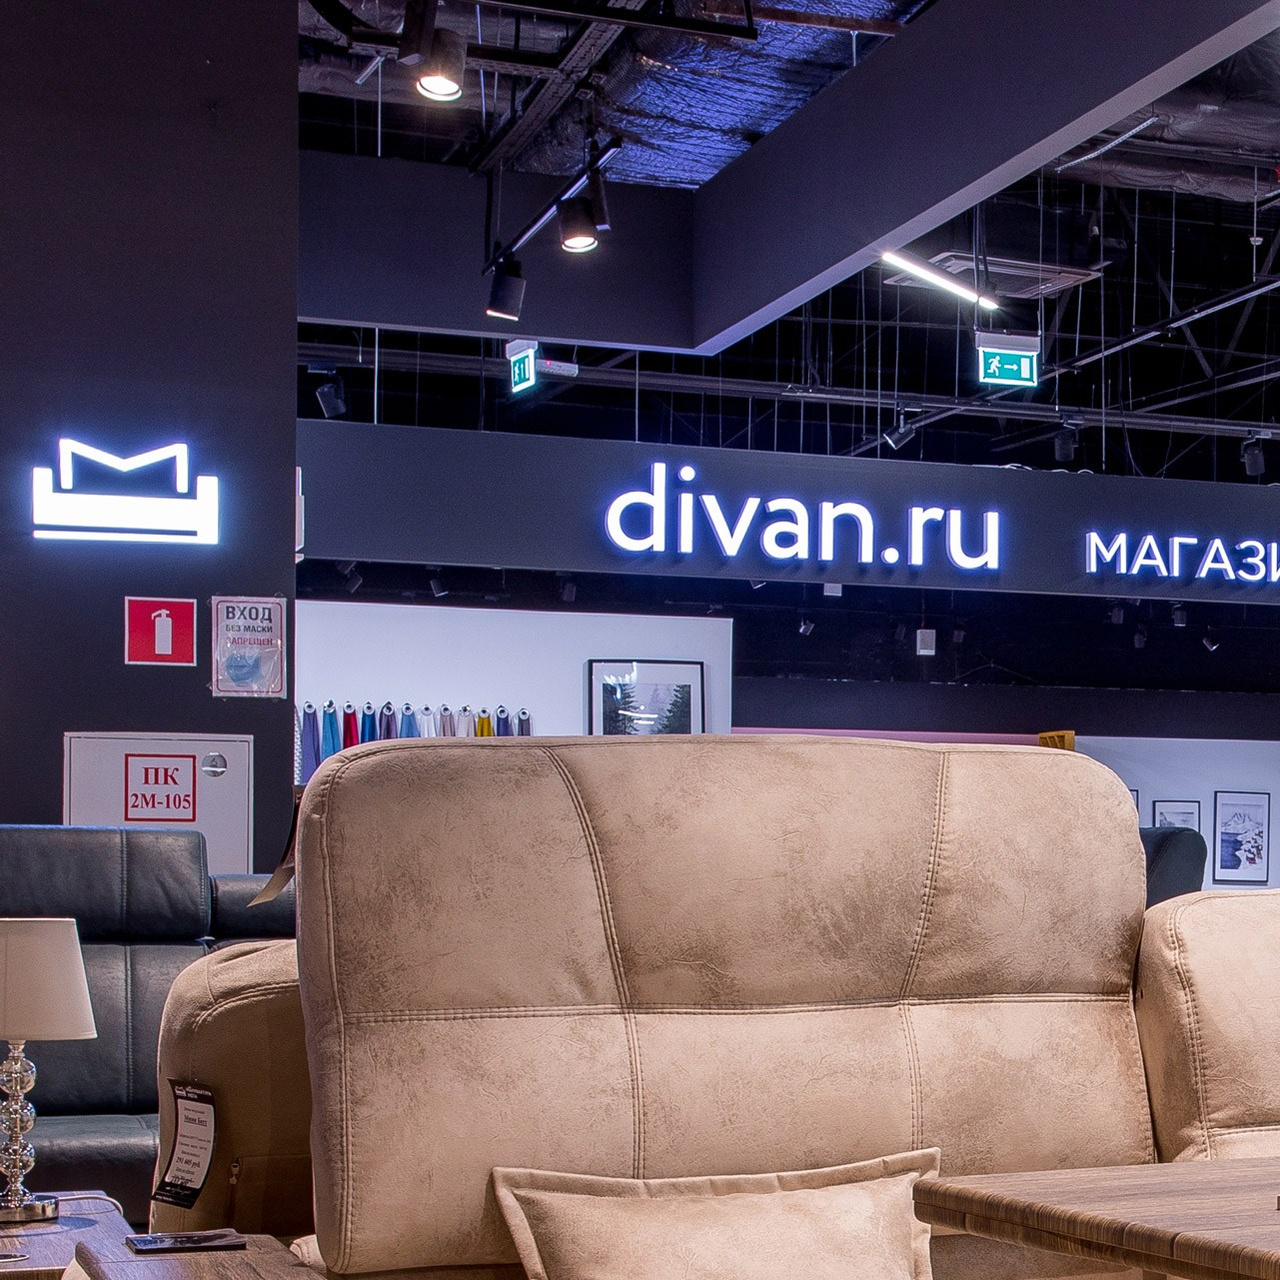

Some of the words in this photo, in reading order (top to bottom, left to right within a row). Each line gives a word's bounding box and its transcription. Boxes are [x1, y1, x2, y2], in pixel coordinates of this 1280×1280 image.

[606, 462, 1000, 570] divan.ru
[225, 605, 273, 623] ВХОД
[225, 624, 241, 632] БЕЗ
[243, 625, 273, 633] МАСКИ
[142, 767, 180, 785] ПК
[130, 793, 191, 809] 2М-105
